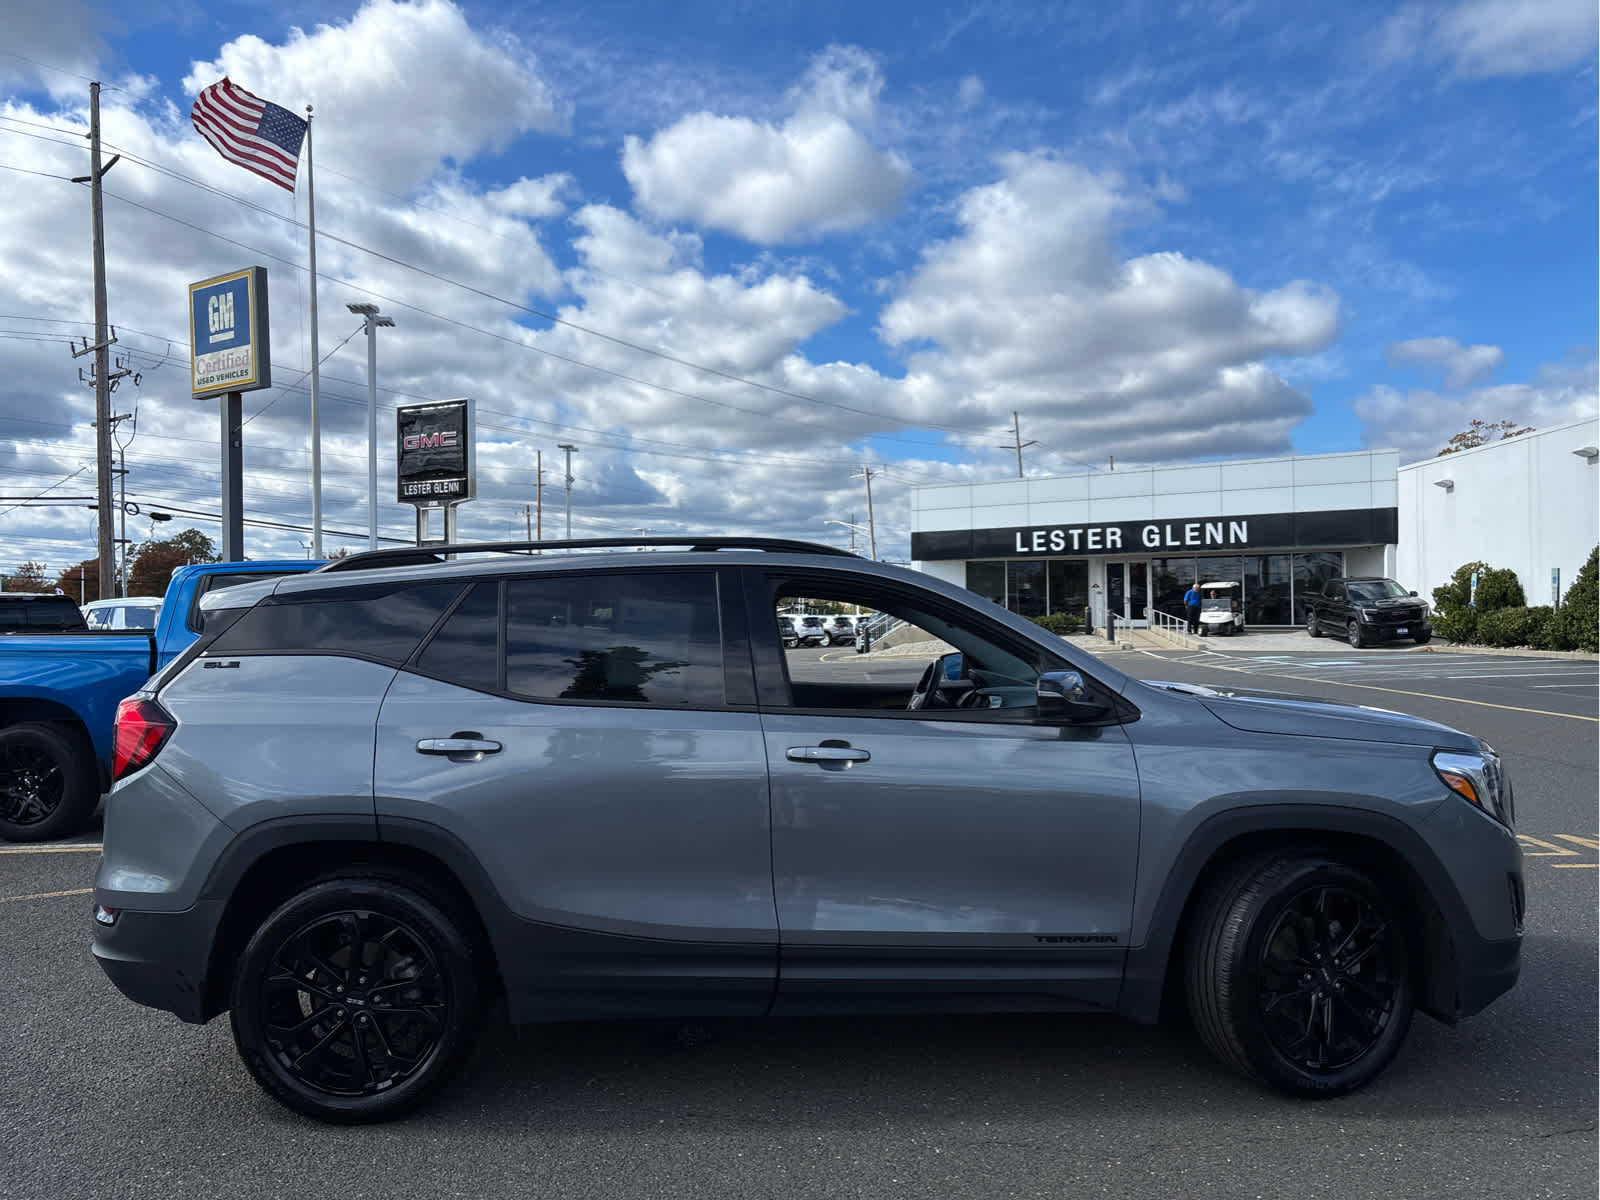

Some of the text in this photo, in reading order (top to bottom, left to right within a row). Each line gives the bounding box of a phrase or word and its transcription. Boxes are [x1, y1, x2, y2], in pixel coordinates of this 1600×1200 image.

[208, 292, 235, 333] GM
[196, 350, 250, 376] Certified
[197, 368, 249, 385] USED VEHICLES
[404, 431, 457, 449] GMC
[404, 481, 460, 496] LESTER GLENN
[1015, 520, 1248, 553] LESTER GLENN
[1033, 935, 1119, 944] TERRAIN
